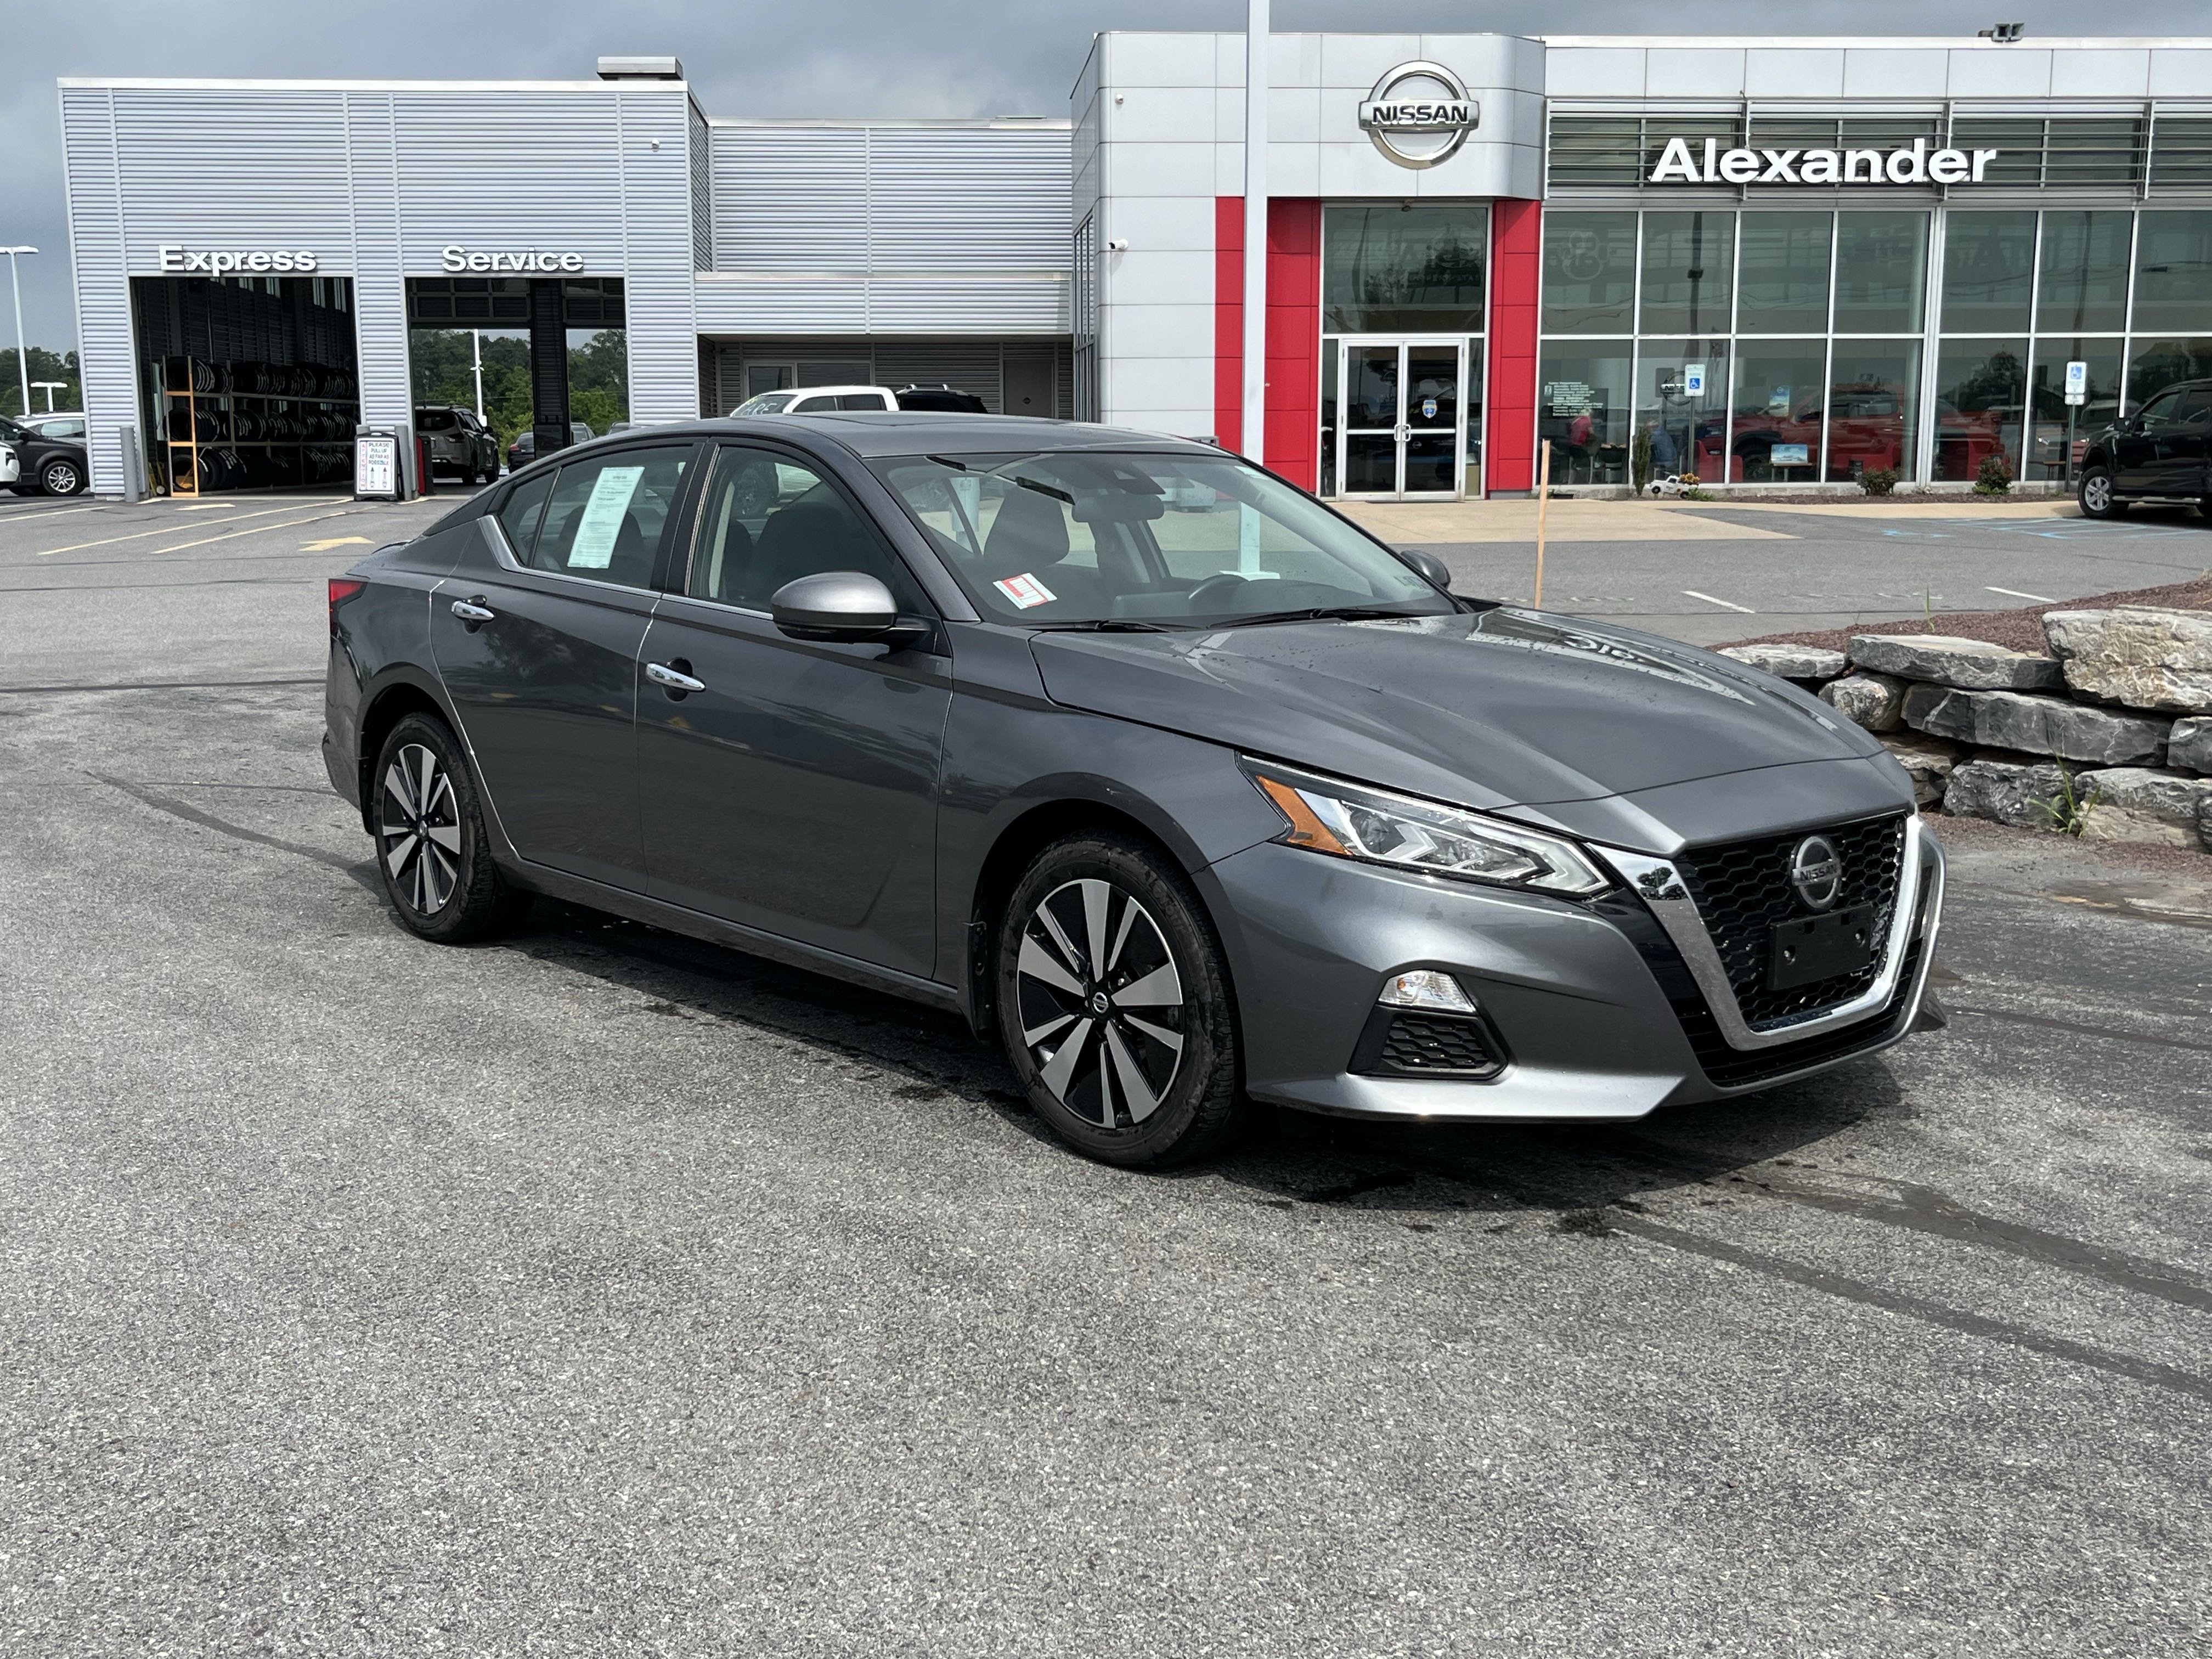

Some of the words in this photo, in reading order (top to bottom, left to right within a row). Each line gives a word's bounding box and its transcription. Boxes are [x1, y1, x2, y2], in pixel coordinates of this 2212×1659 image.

[1372, 105, 1469, 124] NISSAN
[1649, 137, 1997, 184] Alexander
[159, 245, 317, 276] Express
[442, 245, 584, 272] Service
[1799, 864, 1837, 881] NISSAN
